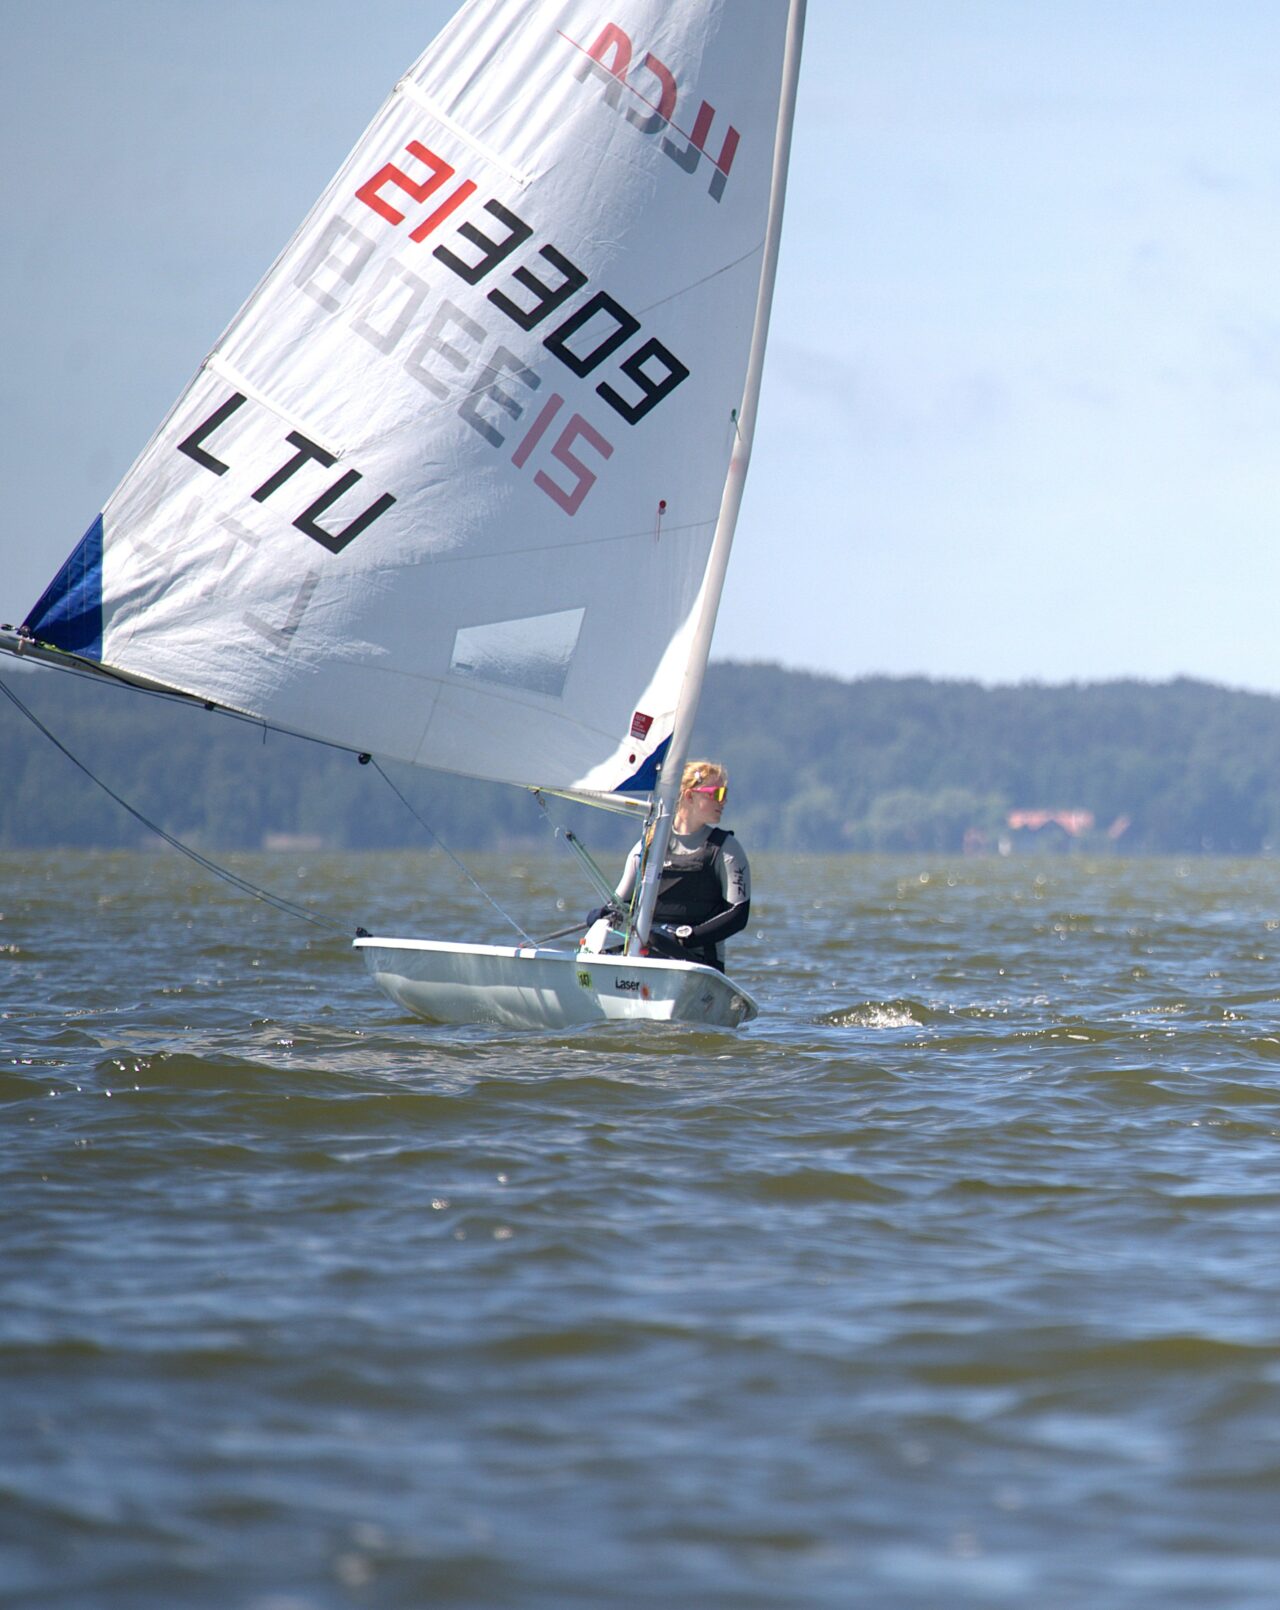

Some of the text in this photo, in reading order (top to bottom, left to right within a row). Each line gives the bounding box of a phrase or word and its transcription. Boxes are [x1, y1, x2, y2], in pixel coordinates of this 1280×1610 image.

[355, 140, 690, 425] 213309
[176, 392, 396, 554] LTU
[615, 976, 640, 990] Laser
